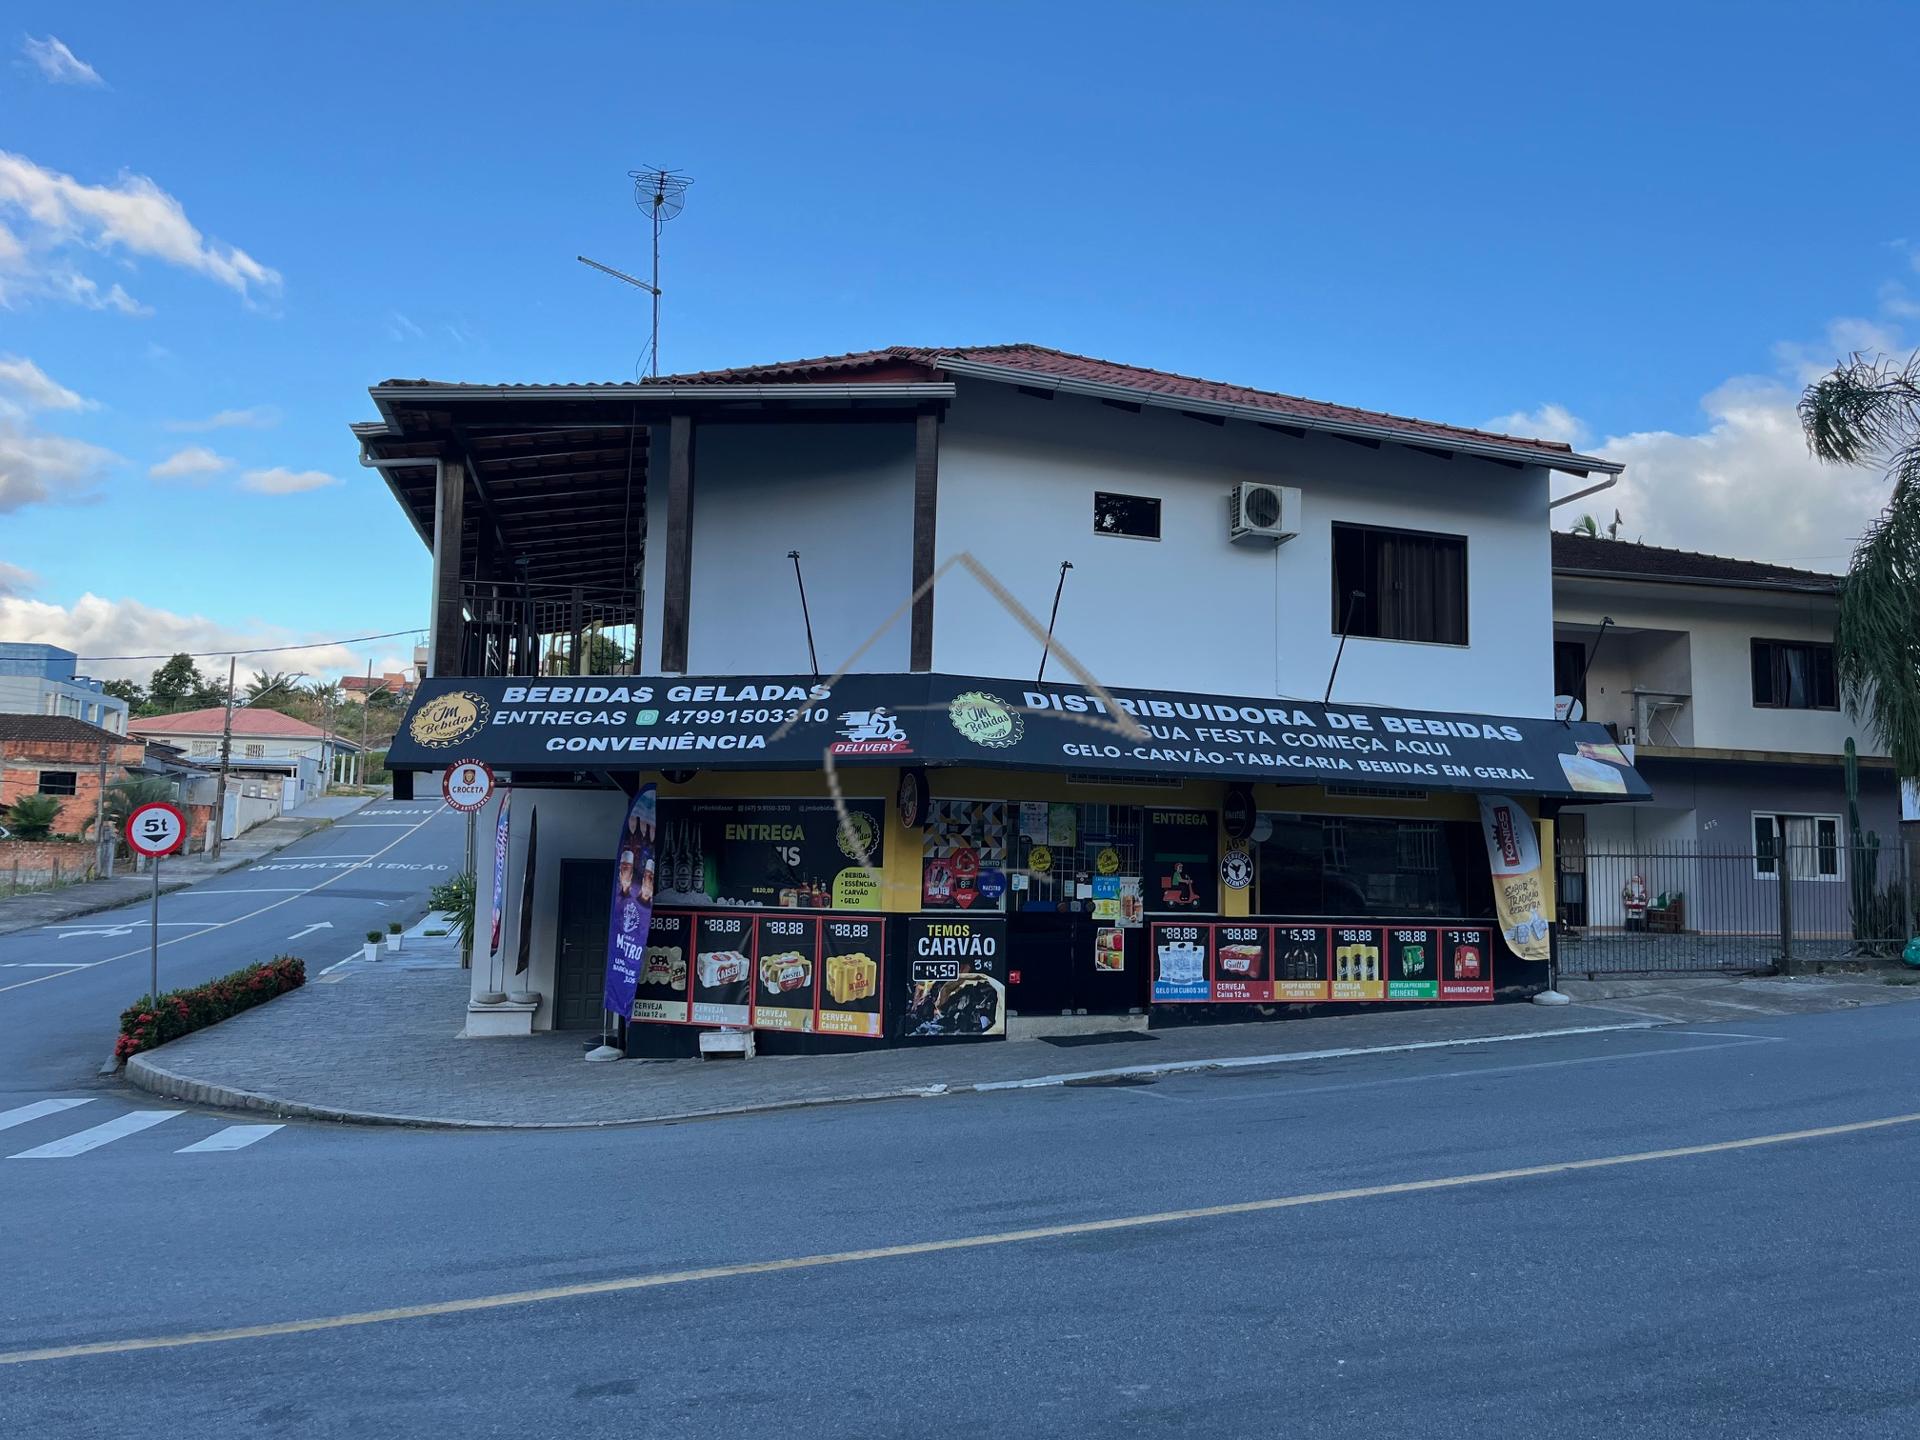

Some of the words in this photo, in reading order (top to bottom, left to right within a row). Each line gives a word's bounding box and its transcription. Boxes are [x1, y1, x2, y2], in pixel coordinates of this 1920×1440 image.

[501, 686, 655, 703] BEBIDAS
[666, 683, 831, 702] GELADAS
[492, 710, 628, 726] ENTREGAS
[665, 708, 829, 724] 47991503310
[1023, 691, 1317, 728] DISTRIBUIDORA
[1324, 712, 1374, 731] DE
[1380, 716, 1523, 742] BEBIDAS
[421, 714, 475, 735] Bebidas
[965, 714, 1009, 734] Bebidas
[545, 732, 767, 751] CONVENIÊNCIA
[834, 743, 898, 752] DELIVERY
[1196, 728, 1277, 746] FESTA
[1281, 732, 1389, 753] COMEÇA
[1395, 739, 1452, 756] AQUI
[1357, 759, 1438, 776] BEBIDAS
[1441, 763, 1472, 778] EM
[1474, 766, 1534, 780] GERAL
[1153, 812, 1208, 826] ENTREGA
[725, 824, 805, 841] ENTREGA
[844, 880, 877, 888] ESSÊNCIAS
[844, 888, 868, 896] CARVÃO
[844, 897, 860, 905] GELO
[927, 924, 970, 937] TEMOS
[918, 933, 996, 956] CARVÃO
[650, 955, 669, 966] OPA
[634, 1002, 663, 1010] CERVEJA
[695, 1004, 724, 1014] CERVEJA
[757, 1009, 787, 1018] CERVEJA
[822, 1013, 852, 1022] CERVEJA
[757, 1017, 773, 1025] Caixa
[775, 1018, 783, 1026] 12
[822, 1021, 839, 1029] Caixa
[840, 1022, 848, 1030] 12
